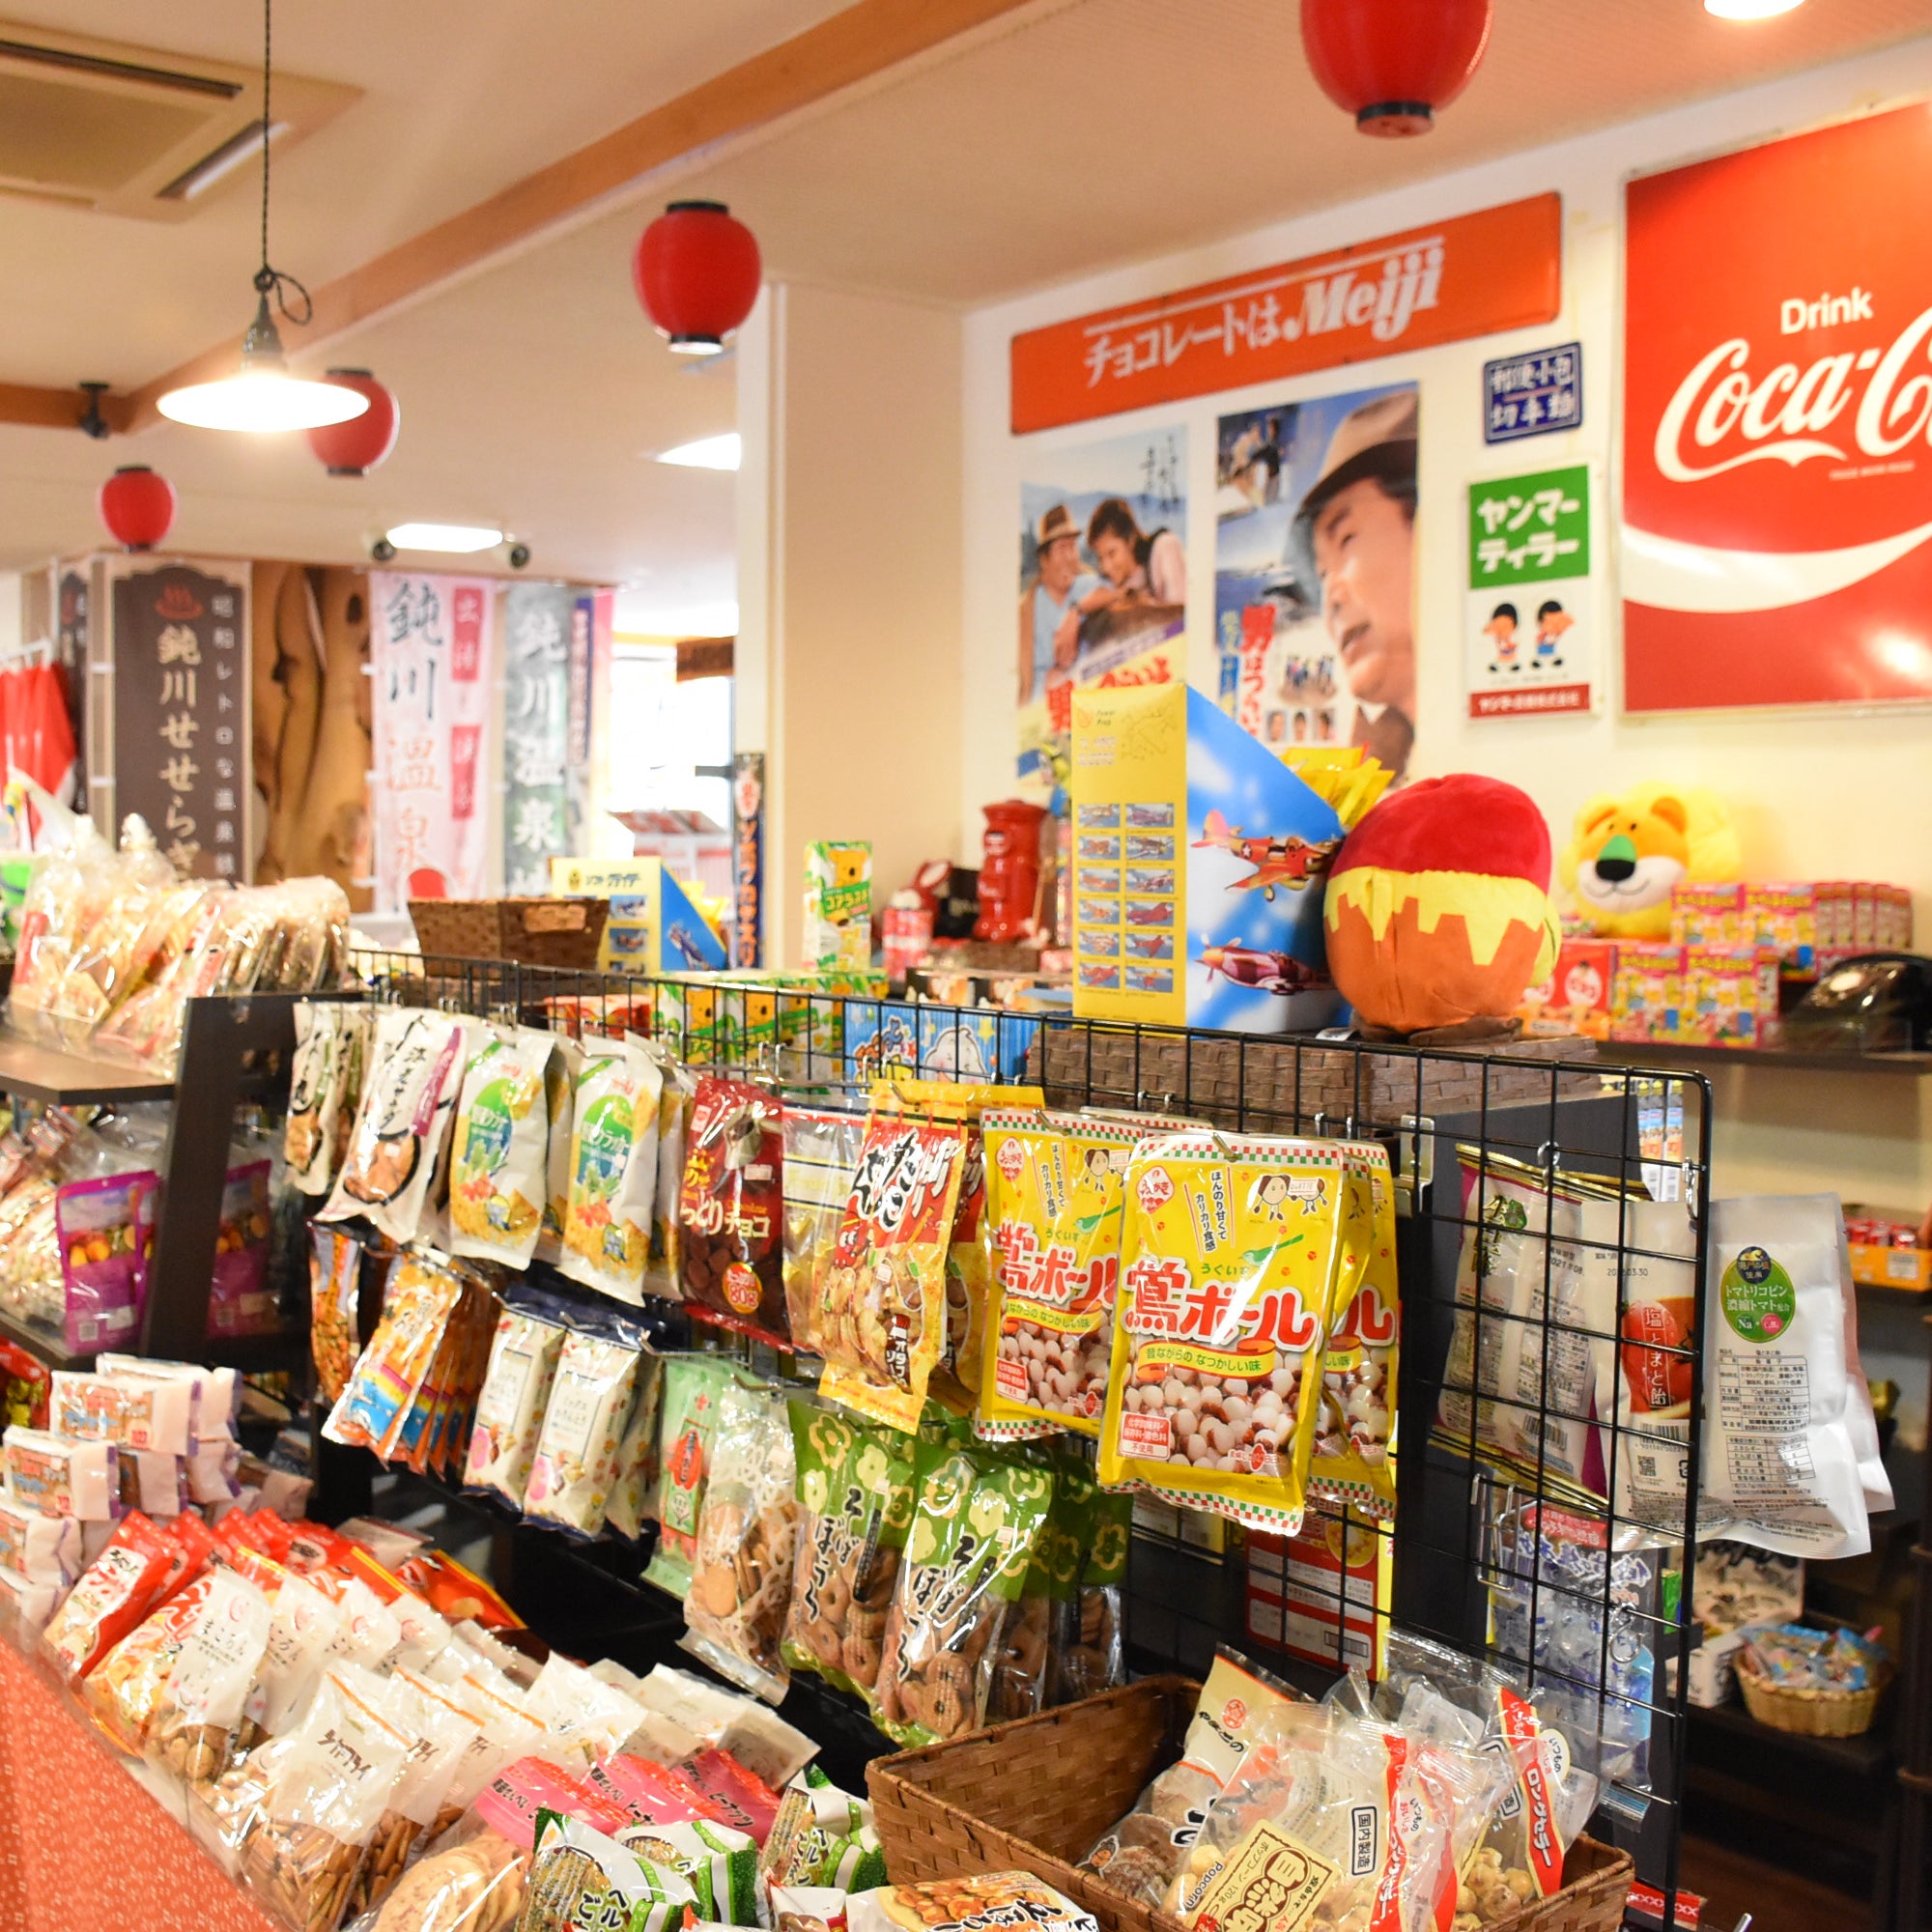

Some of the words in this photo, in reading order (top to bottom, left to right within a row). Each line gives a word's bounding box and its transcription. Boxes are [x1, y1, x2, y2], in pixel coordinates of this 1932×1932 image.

[1083, 296, 1282, 388] チョコレートは
[1283, 247, 1446, 341] Meiji
[1781, 287, 1873, 334] Drink
[1655, 303, 1932, 482] Coca-C
[1477, 488, 1580, 534] ヤンマー
[1040, 1163, 1058, 1218] カリカリ食感
[1211, 1171, 1227, 1240] ほんのり甘くて
[1196, 1194, 1216, 1253] カリカリ食感
[1006, 1302, 1038, 1319] ながらの
[1725, 1285, 1789, 1298] トマトリコピン
[1146, 1347, 1193, 1362] 昔ながらの
[1195, 1353, 1262, 1372] なつかしい味
[1356, 1813, 1372, 1869] 国内製造
[1526, 1767, 1553, 1867] ロングセラー
[1185, 1861, 1224, 1910] Popcorn
[1238, 1842, 1269, 1883] ポップコーン
[1221, 1885, 1239, 1904] 120g
